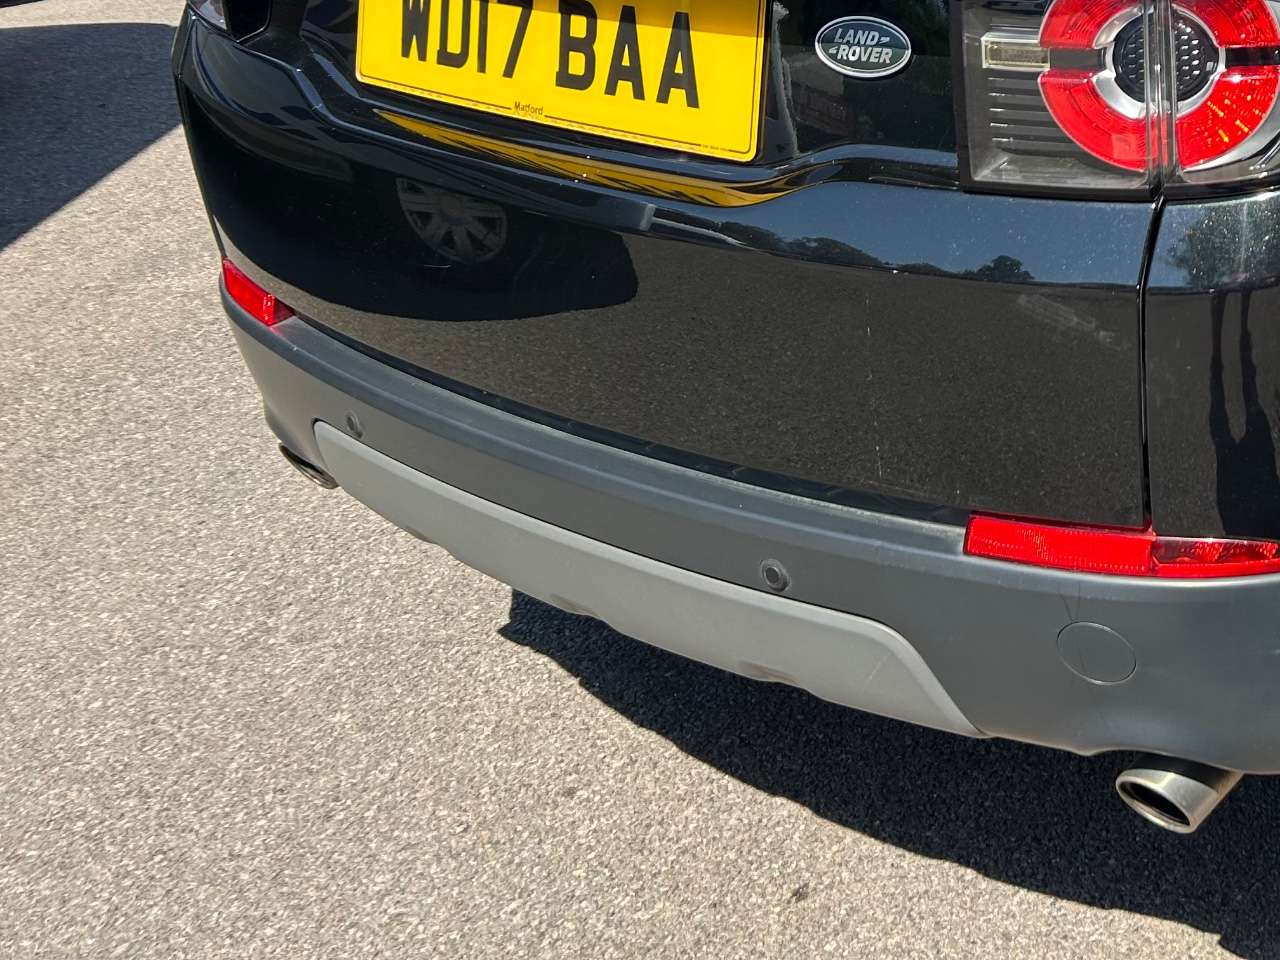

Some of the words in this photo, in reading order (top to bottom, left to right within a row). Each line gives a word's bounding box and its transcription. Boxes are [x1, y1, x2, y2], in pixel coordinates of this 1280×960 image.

[834, 28, 879, 45] LAND
[836, 44, 893, 64] ROVER
[514, 100, 544, 116] Matford
